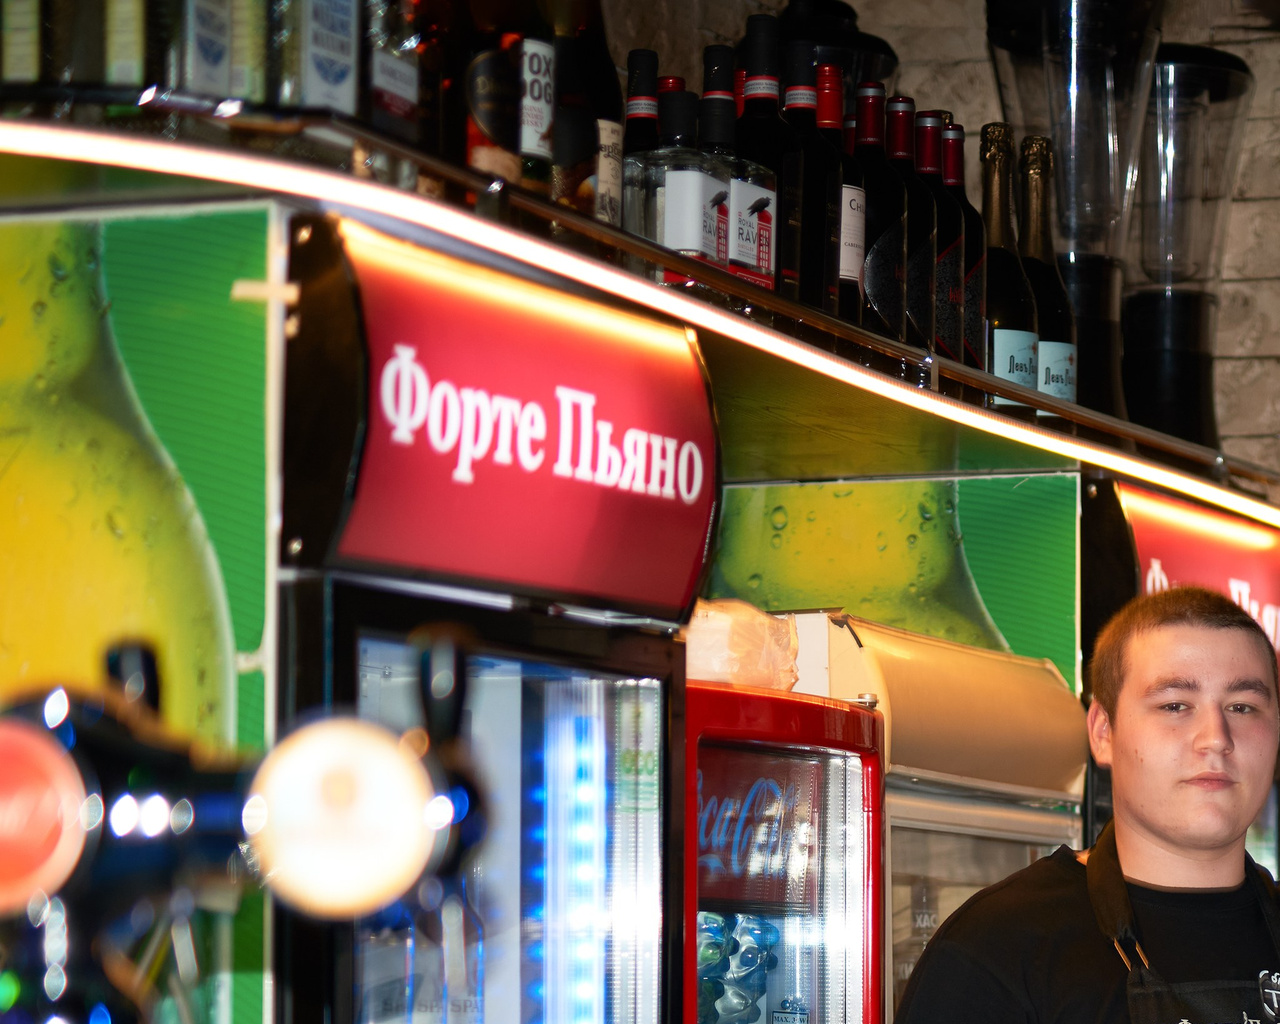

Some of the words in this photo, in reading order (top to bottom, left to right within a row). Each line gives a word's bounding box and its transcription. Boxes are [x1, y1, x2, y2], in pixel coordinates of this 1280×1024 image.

[738, 218, 755, 230] ROYAL
[380, 343, 547, 484] Форте
[553, 385, 703, 505] Пьяно
